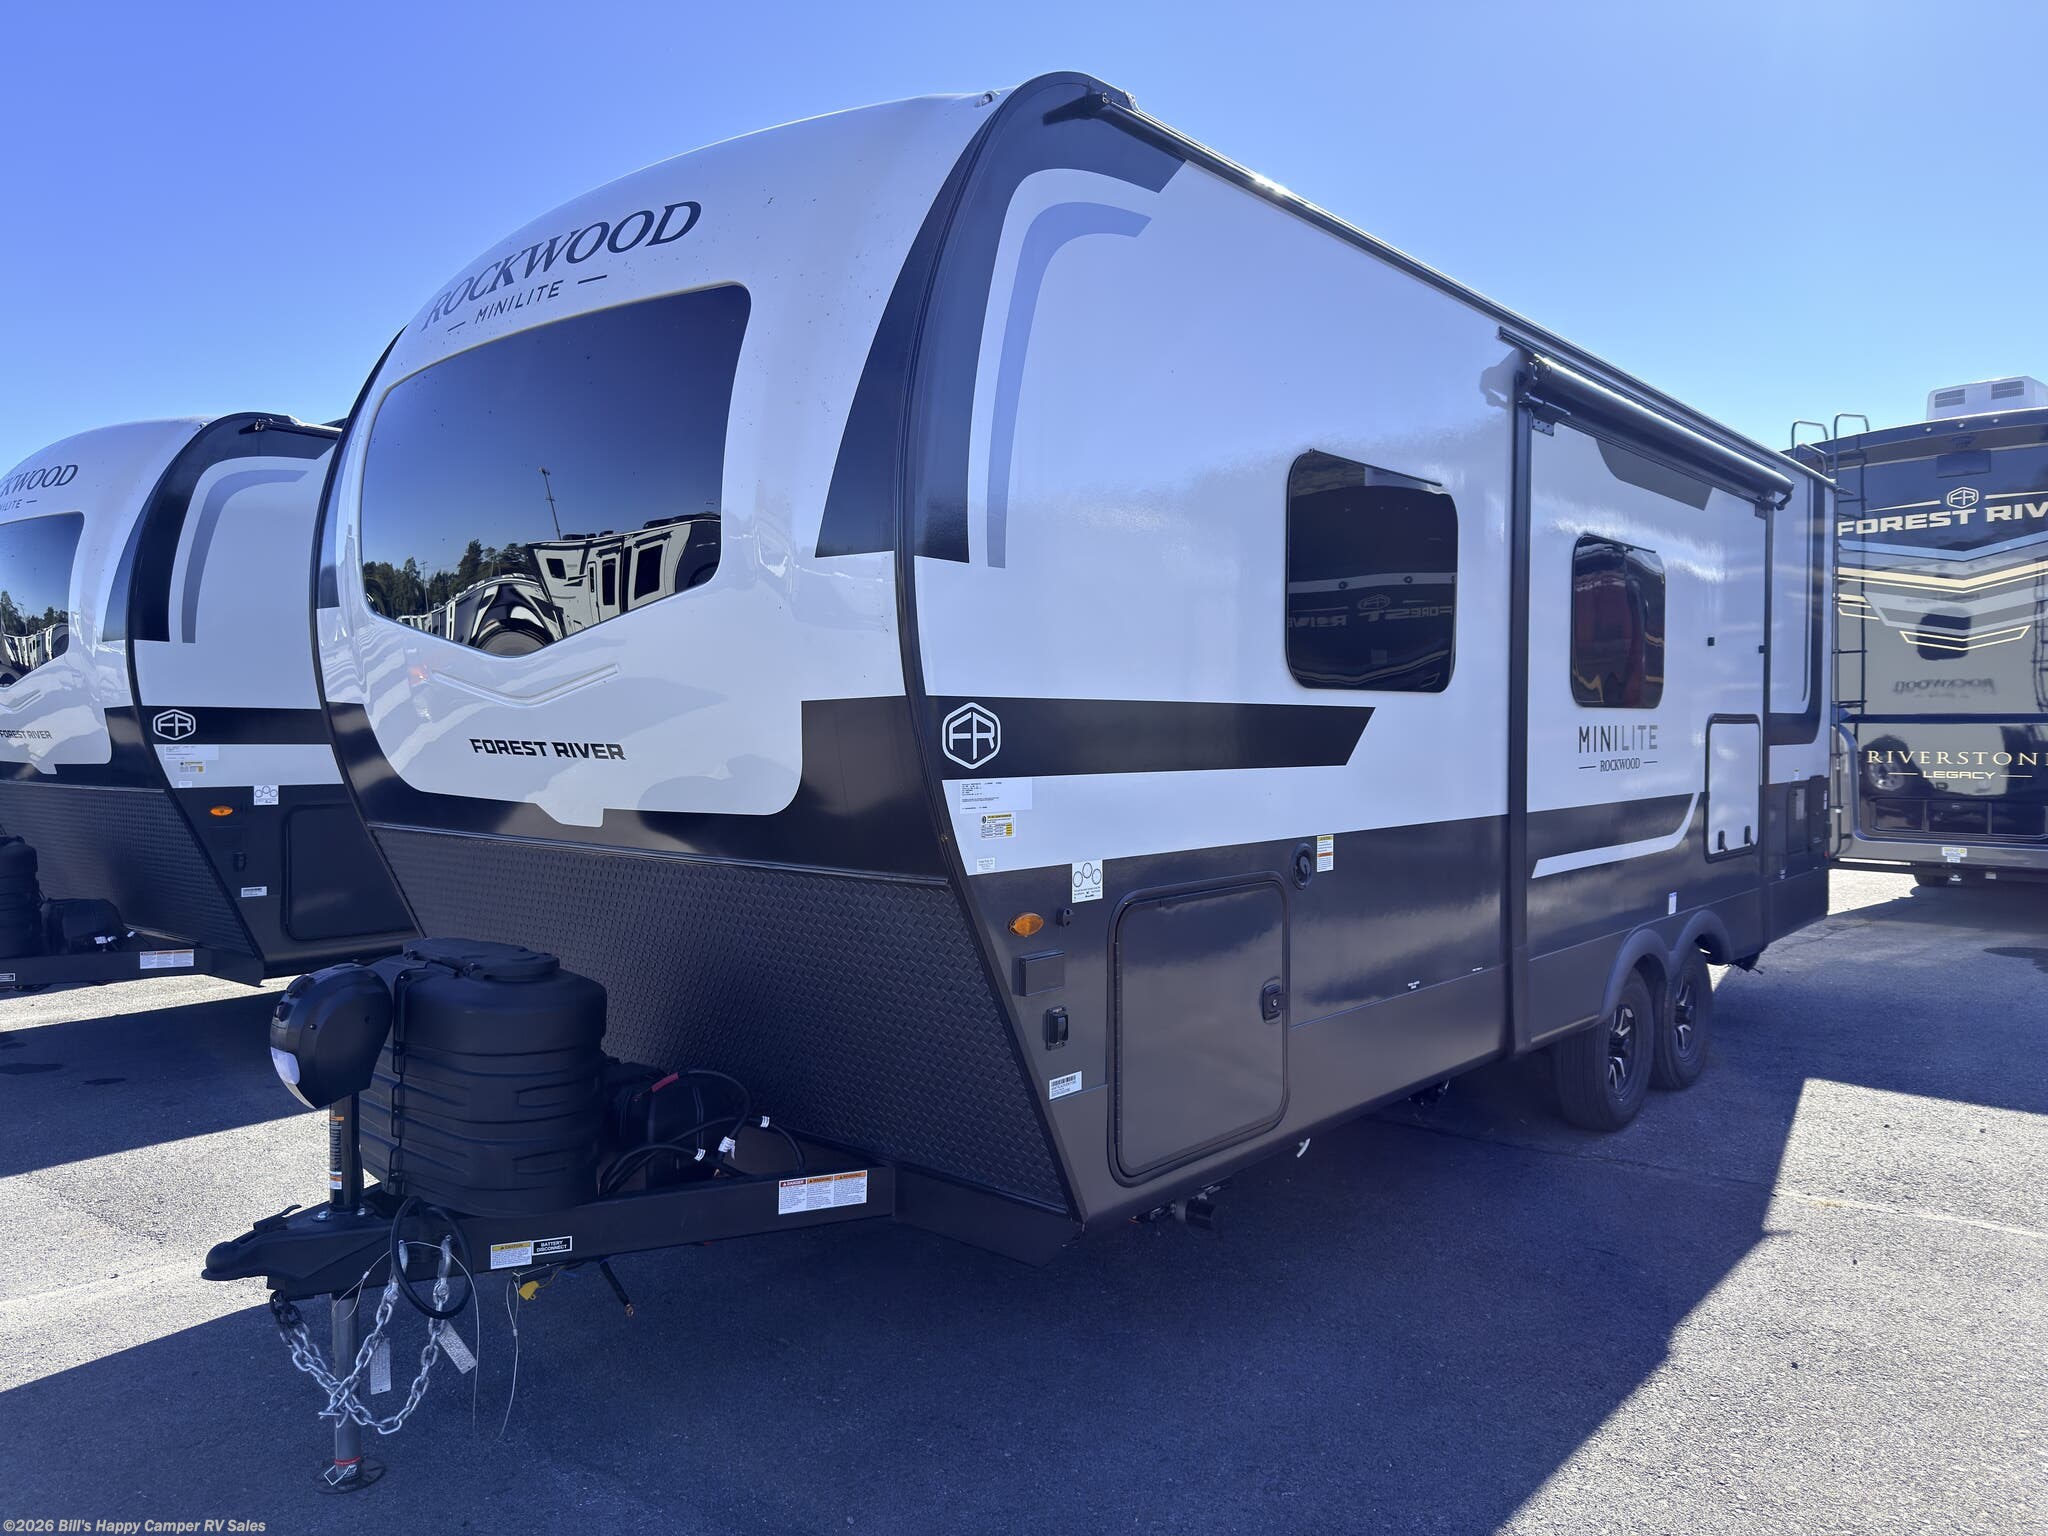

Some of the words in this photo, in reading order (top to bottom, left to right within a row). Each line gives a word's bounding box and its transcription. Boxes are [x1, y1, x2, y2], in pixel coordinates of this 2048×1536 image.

[420, 200, 702, 333] ROCKWOOD
[474, 279, 564, 324] MINILITE
[1837, 508, 1977, 537] FOREST
[0, 729, 27, 739] FOREST
[26, 730, 53, 740] RIVER
[948, 710, 996, 761] FR
[1578, 724, 1659, 753] MINILITE
[468, 738, 548, 757] FOREST
[550, 741, 628, 761] RIVER
[1600, 757, 1641, 772] ROCKWOOD
[1922, 770, 1996, 780] LEGACY
